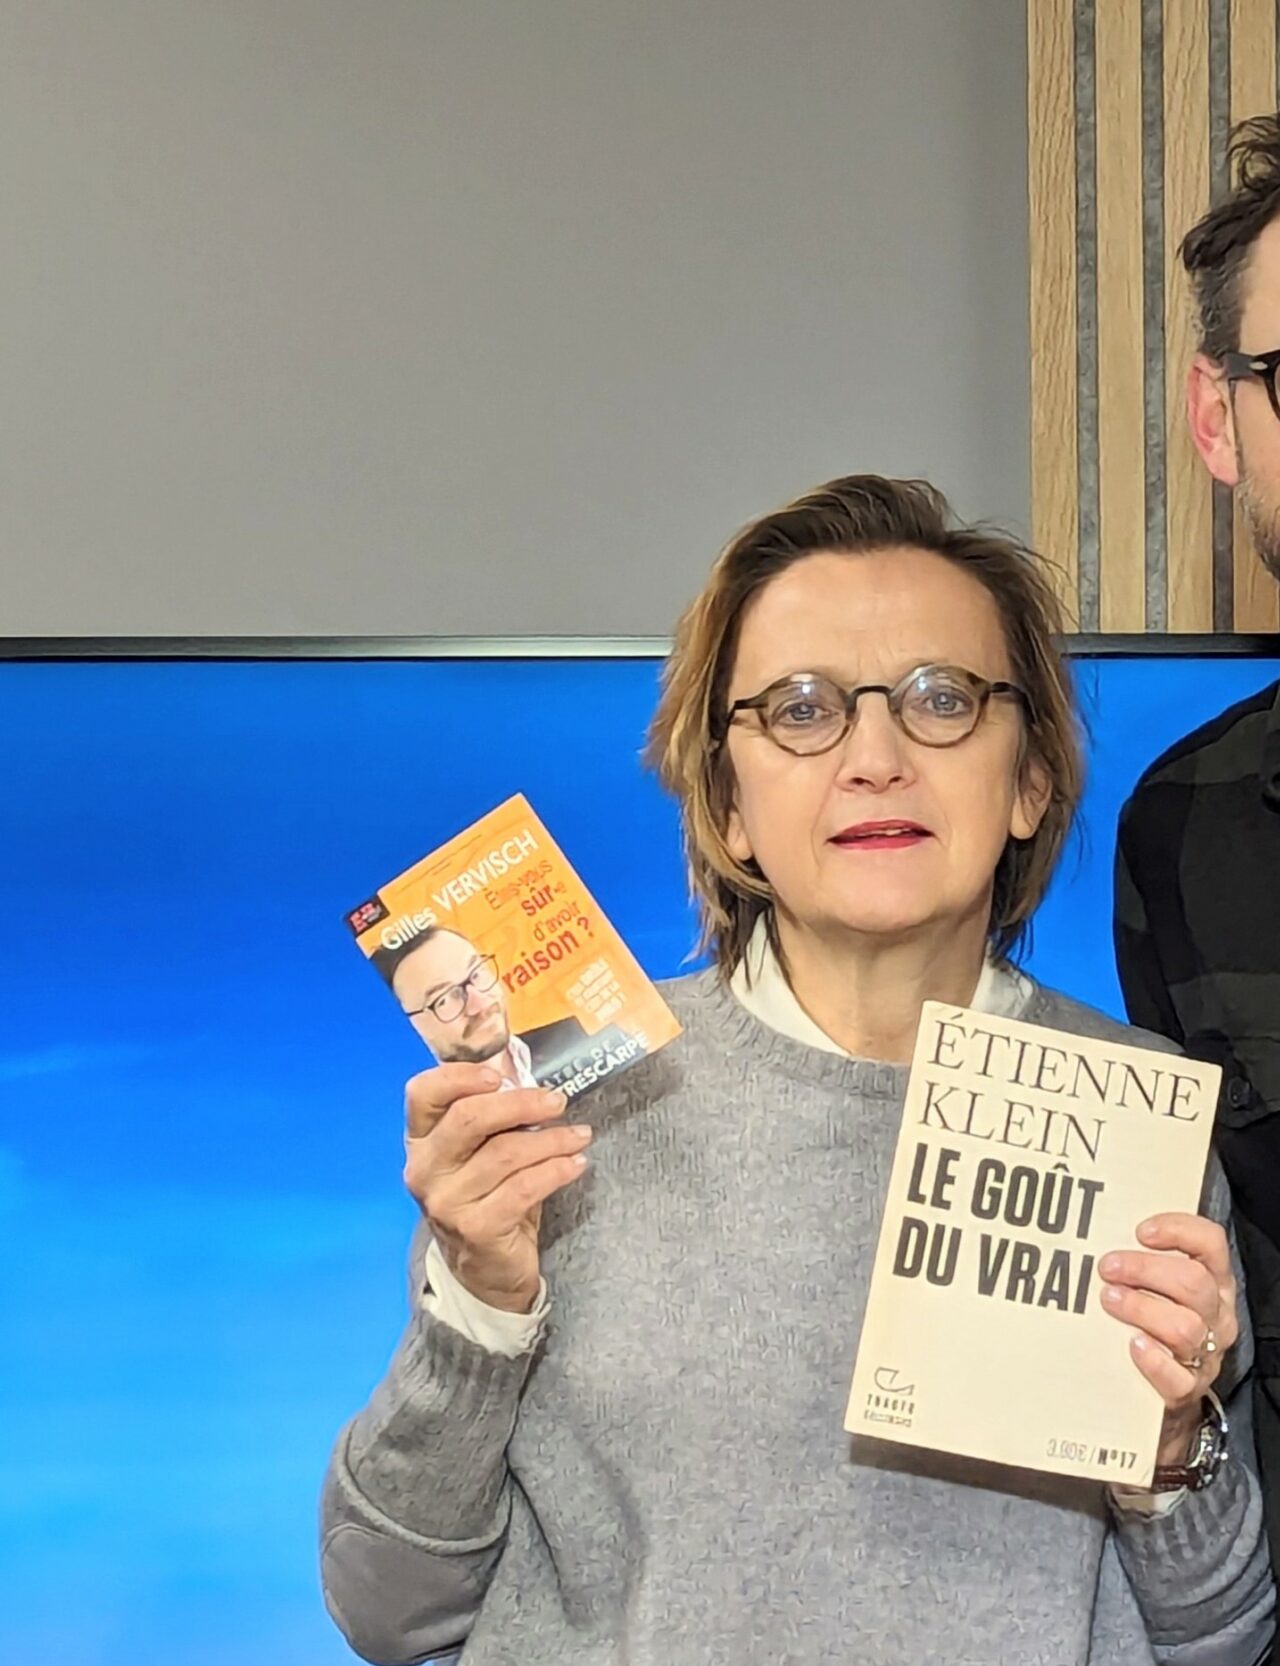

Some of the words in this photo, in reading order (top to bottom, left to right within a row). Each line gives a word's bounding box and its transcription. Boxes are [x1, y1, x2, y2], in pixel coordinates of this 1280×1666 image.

[380, 906, 438, 951] Gilles
[432, 828, 539, 912] VERVISCH
[501, 929, 580, 993] raison
[577, 916, 595, 939] ?
[927, 1013, 1202, 1121] ÉTIENNE
[917, 1081, 1106, 1163] KLEIN
[906, 1142, 961, 1211] LE
[970, 1157, 1105, 1241] GOÛT
[892, 1217, 963, 1287] DU
[977, 1234, 1095, 1316] VRAI
